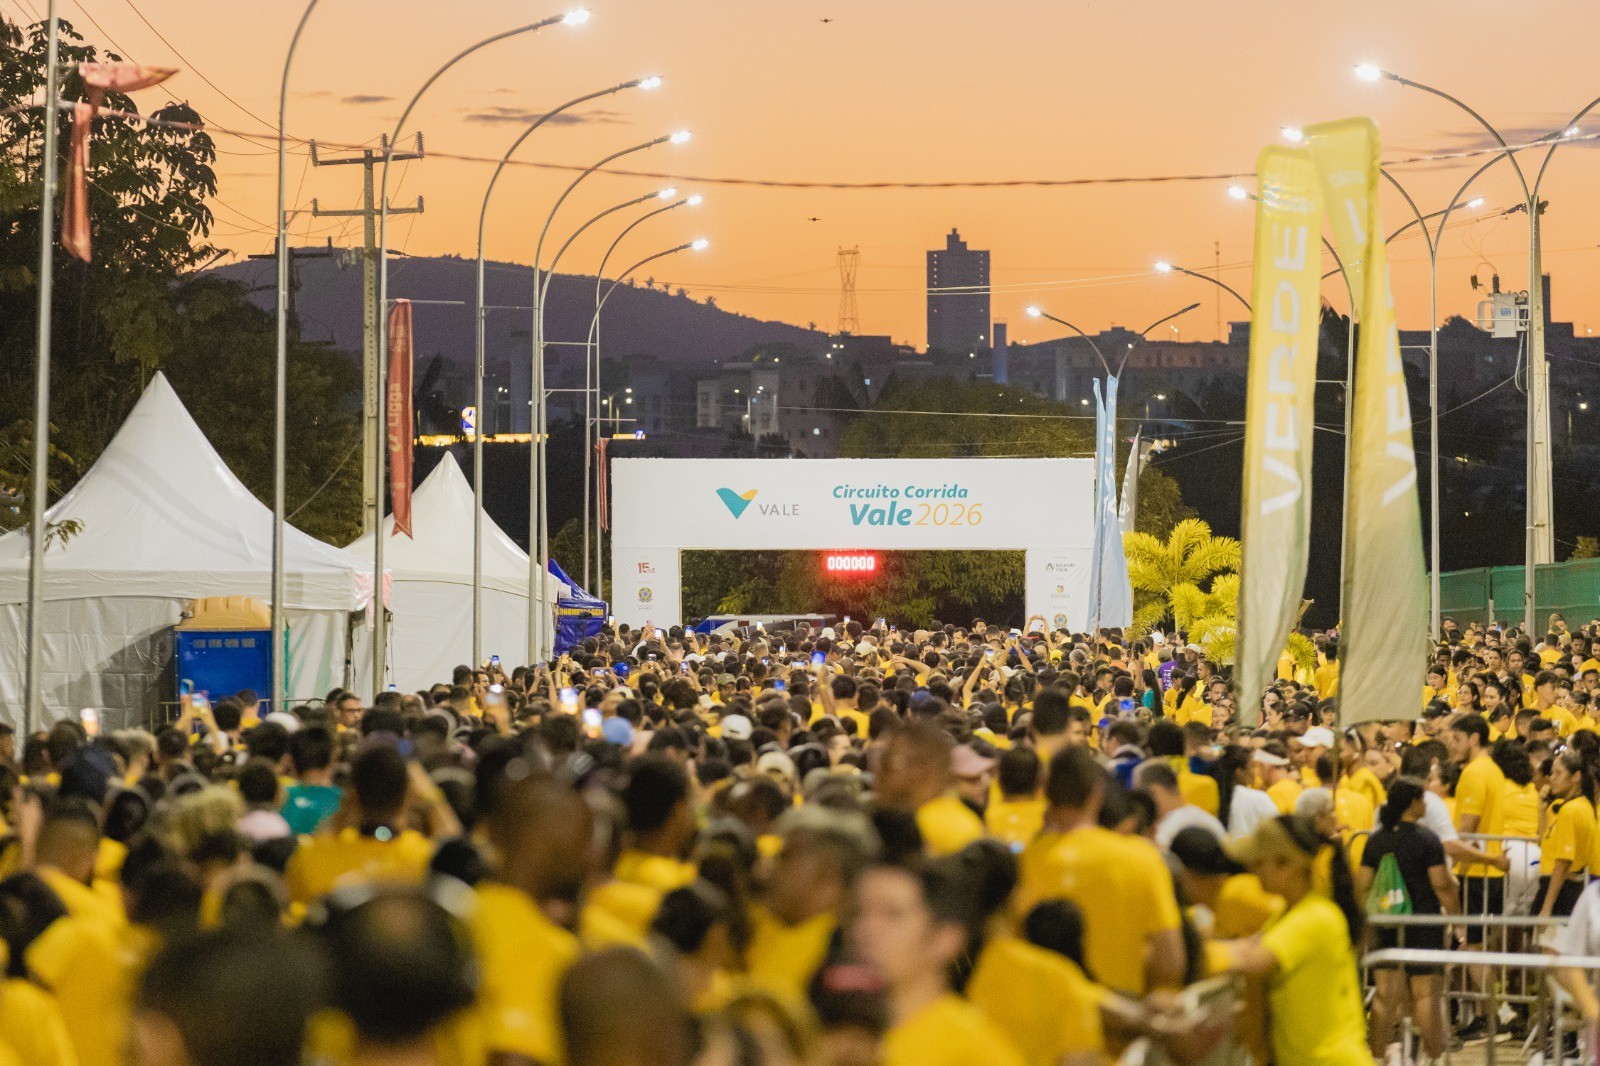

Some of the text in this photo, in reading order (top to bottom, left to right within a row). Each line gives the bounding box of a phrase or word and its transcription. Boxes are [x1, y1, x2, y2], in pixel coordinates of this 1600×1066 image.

[1261, 222, 1307, 516] VERDE
[832, 483, 968, 499] Circuito Corrida
[759, 503, 799, 516] VALE
[850, 500, 983, 526] Vale 2026
